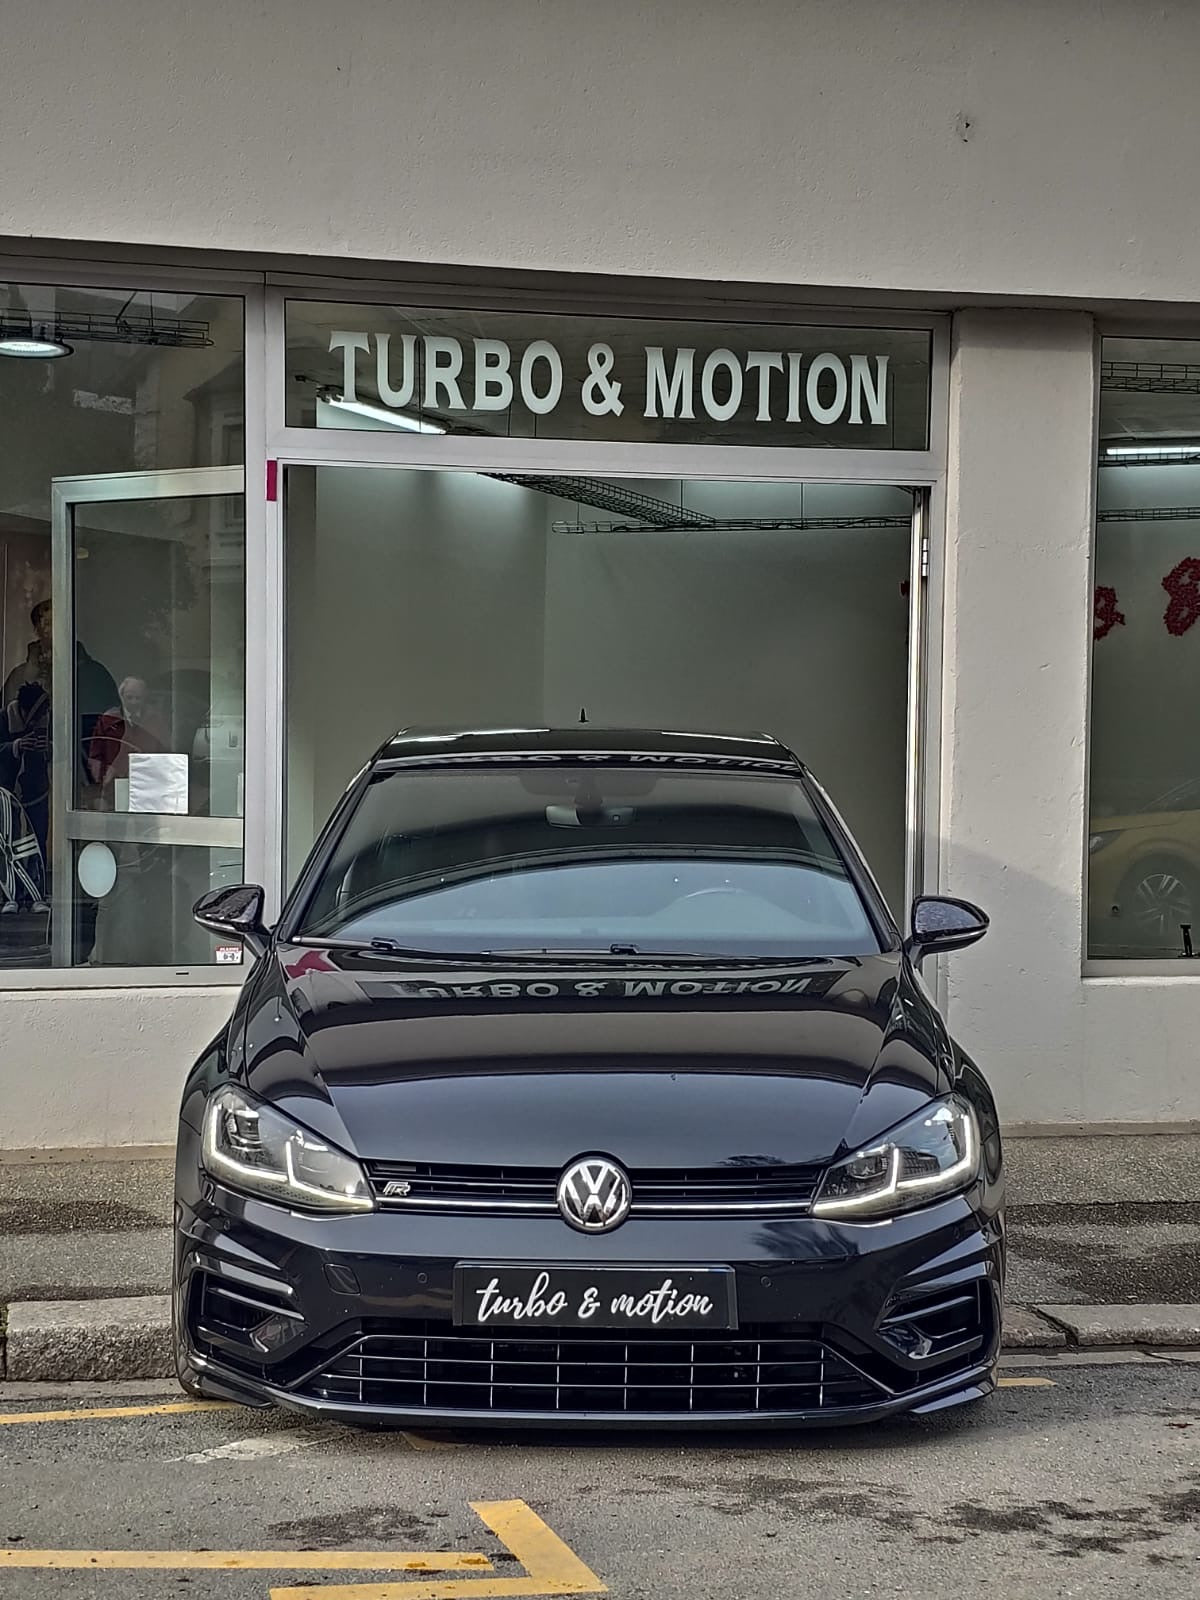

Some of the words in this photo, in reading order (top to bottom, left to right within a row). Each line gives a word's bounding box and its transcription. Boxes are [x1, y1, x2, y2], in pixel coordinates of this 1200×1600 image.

[329, 331, 562, 415] TURBO
[582, 342, 624, 417] &
[644, 346, 889, 424] MOTION
[476, 1271, 567, 1322] turbo
[578, 1287, 600, 1319] &
[611, 1279, 713, 1323] motion
